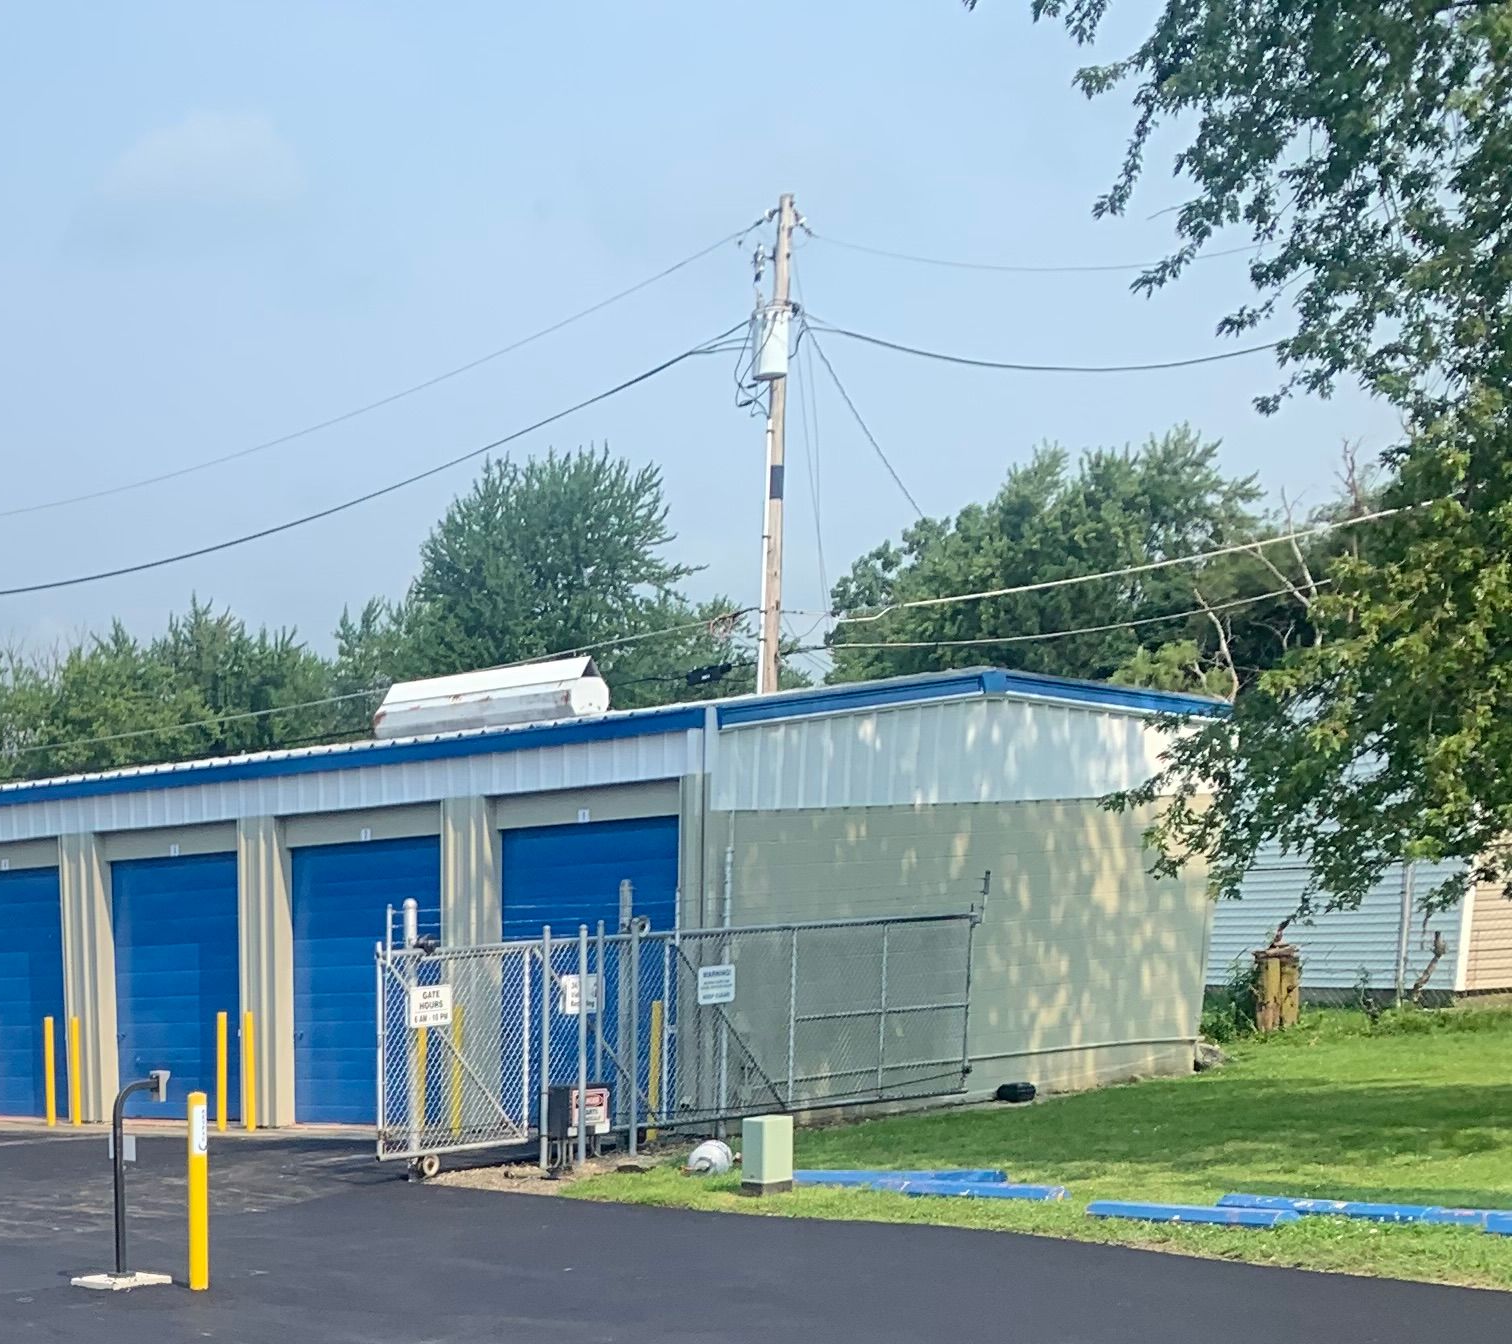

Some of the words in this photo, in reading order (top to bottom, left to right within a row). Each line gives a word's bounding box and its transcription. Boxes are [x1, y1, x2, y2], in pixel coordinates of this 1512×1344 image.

[422, 990, 440, 1000] GATE
[419, 1000, 443, 1010] HOURS
[419, 1014, 428, 1023] AM
[440, 1012, 449, 1020] PM
